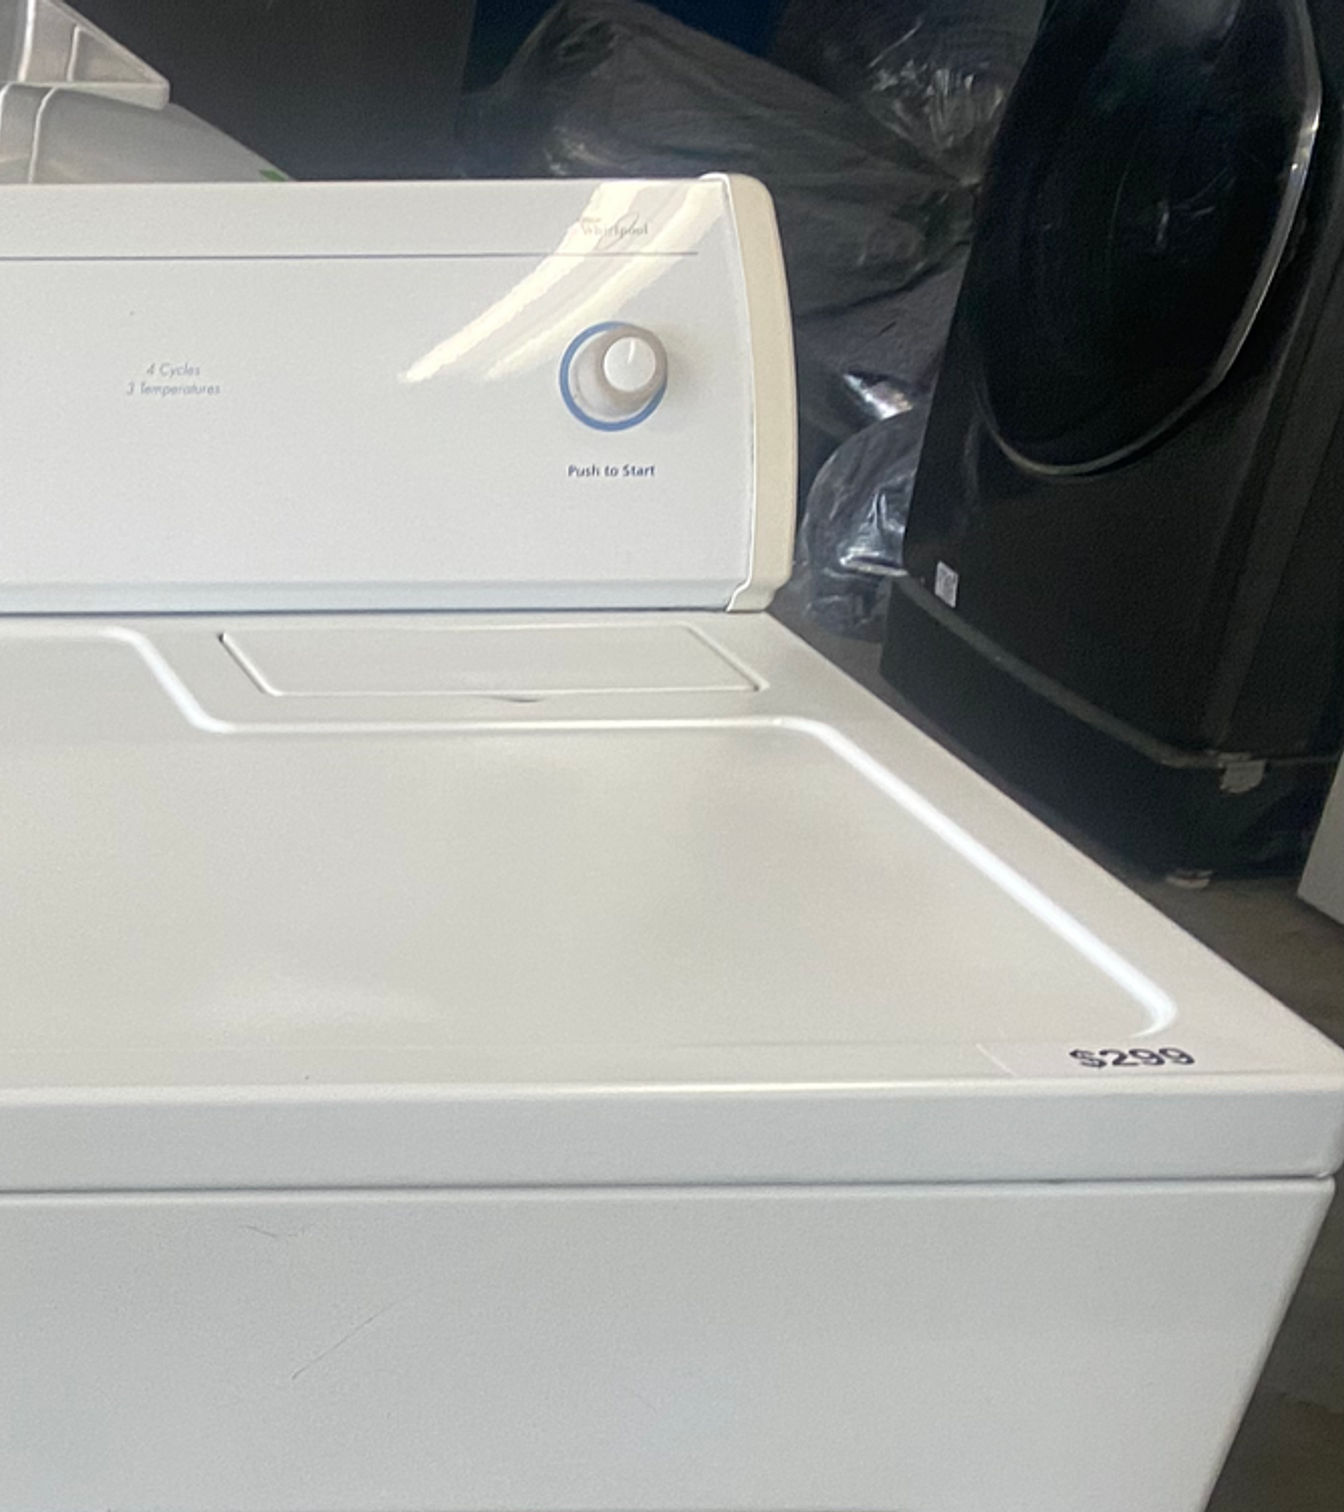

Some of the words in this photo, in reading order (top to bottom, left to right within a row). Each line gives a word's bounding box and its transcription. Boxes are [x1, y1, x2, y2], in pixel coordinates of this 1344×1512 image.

[146, 362, 156, 375] 4
[159, 362, 200, 378] Cycles
[126, 381, 136, 396] 3
[140, 381, 221, 397] Temperatures
[568, 464, 600, 477] Push
[604, 464, 619, 477] to
[622, 464, 655, 477] Start
[1069, 1047, 1195, 1069] $299
